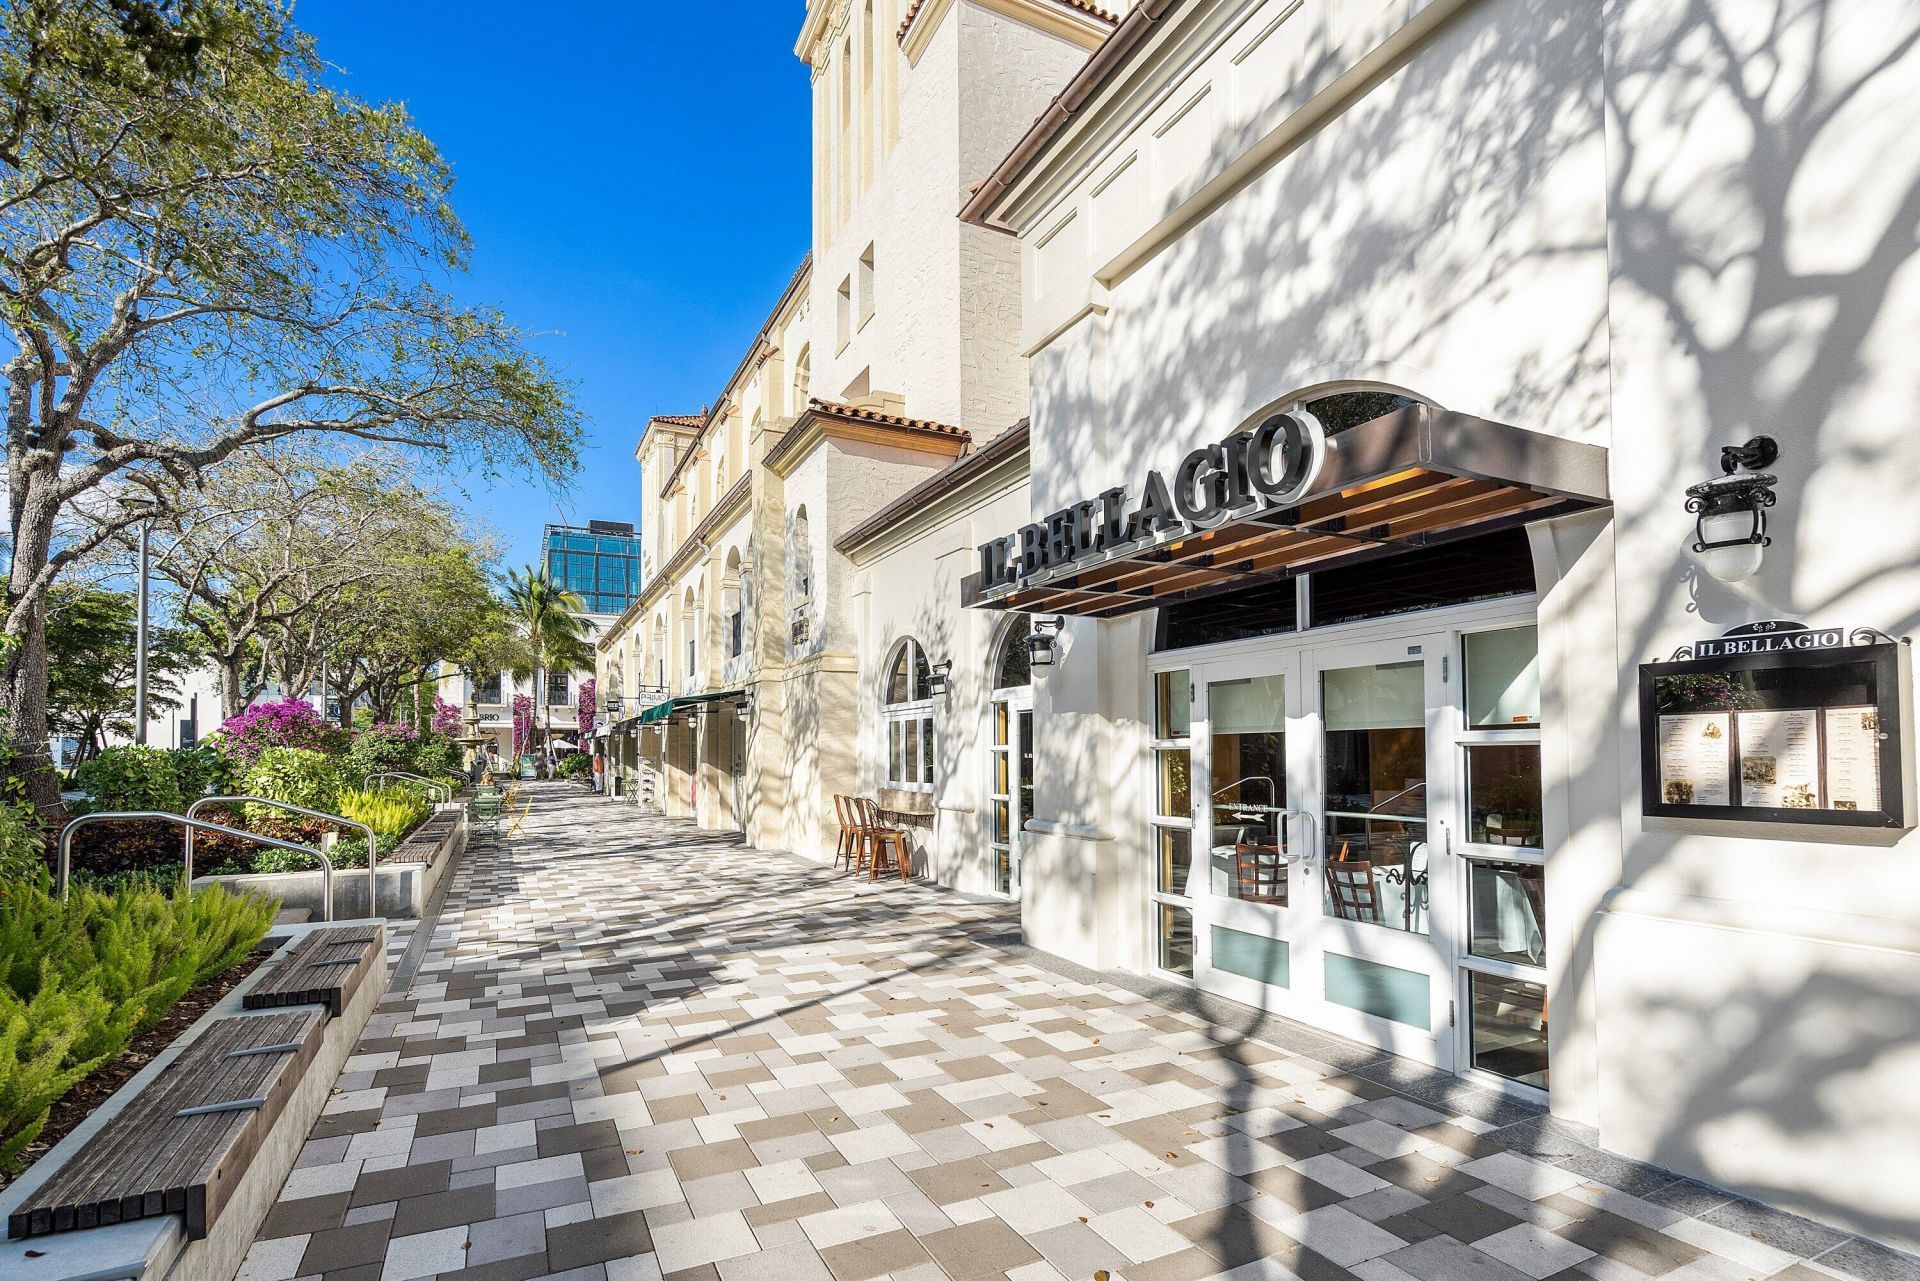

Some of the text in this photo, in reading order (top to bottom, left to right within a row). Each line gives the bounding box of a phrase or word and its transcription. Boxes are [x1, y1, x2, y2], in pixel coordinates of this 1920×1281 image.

[978, 413, 1314, 592] IL BELLAGIO
[1698, 631, 1840, 657] IL BELLAGIO
[640, 693, 667, 702] PRIMO
[479, 713, 500, 721] BRIO
[1228, 803, 1269, 812] ENTRANCE
